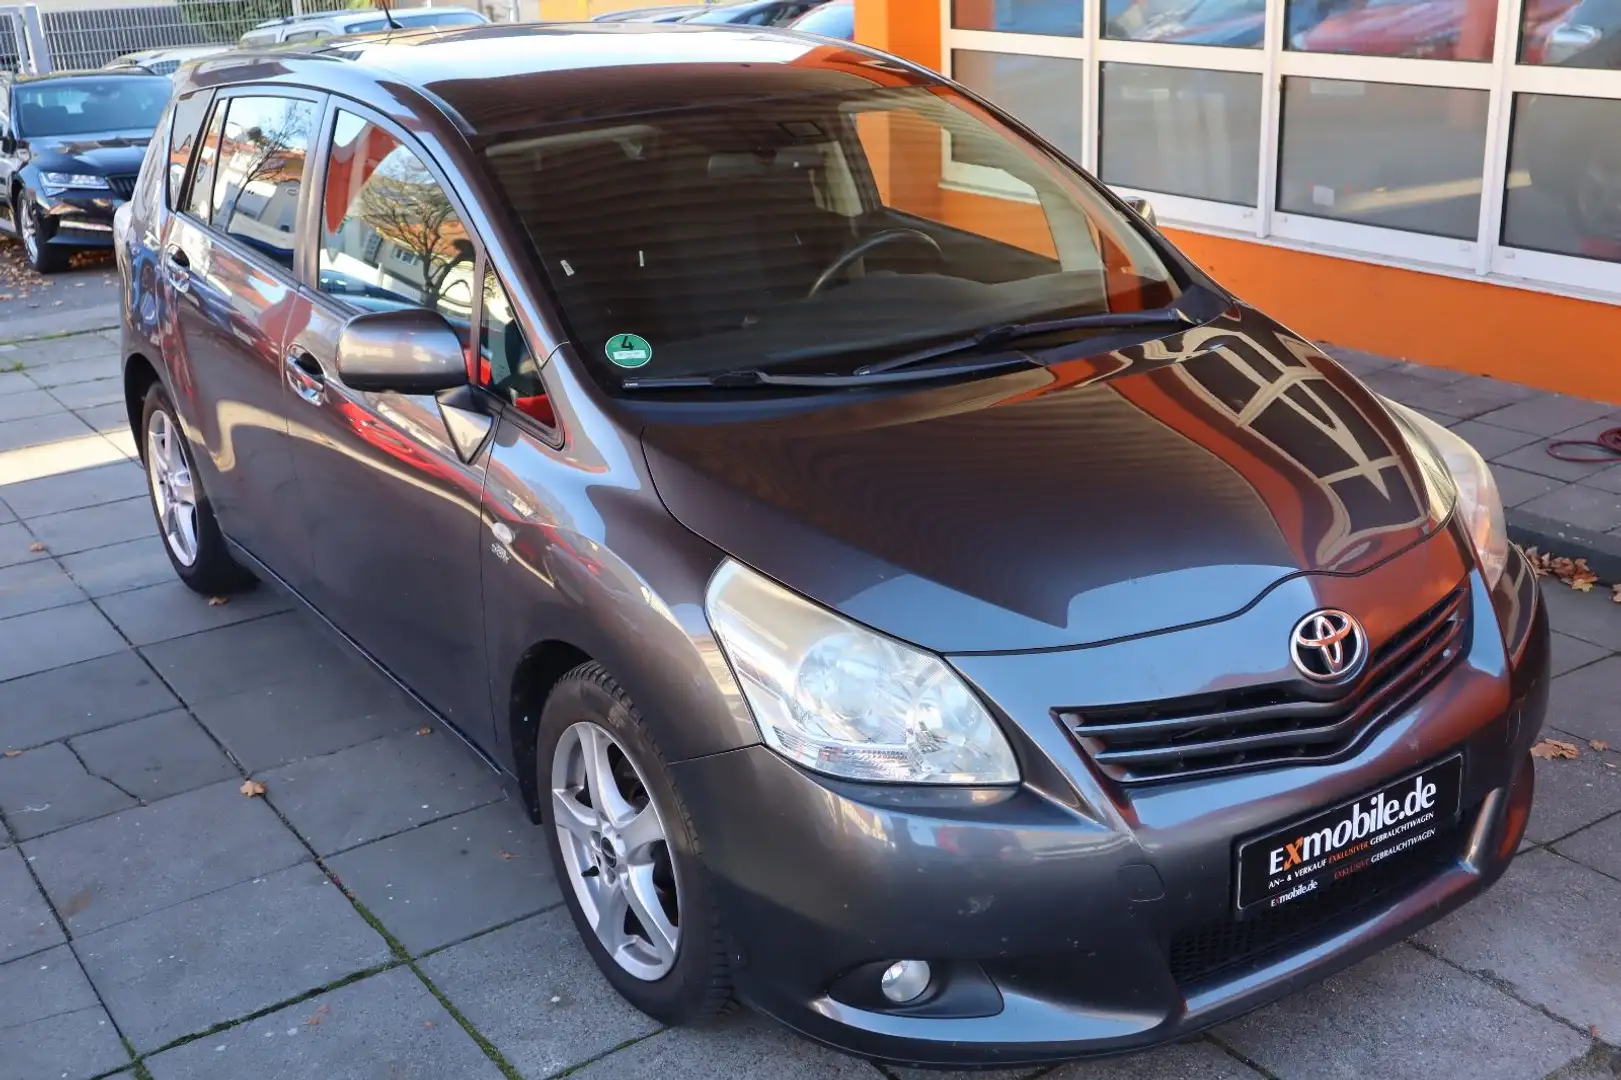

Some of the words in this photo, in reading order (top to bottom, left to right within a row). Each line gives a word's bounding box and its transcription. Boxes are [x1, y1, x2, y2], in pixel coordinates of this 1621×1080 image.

[621, 336, 634, 350] 4
[1268, 879, 1285, 889] AN-
[1295, 858, 1327, 877] VERKAUF
[1328, 841, 1370, 865] EXKLUSIVER
[1370, 811, 1434, 846] GEBRAUCHTWAGEN
[1334, 858, 1370, 880] EXKLUSIVE
[1371, 828, 1436, 863] GEBRAUCHTWAGEN
